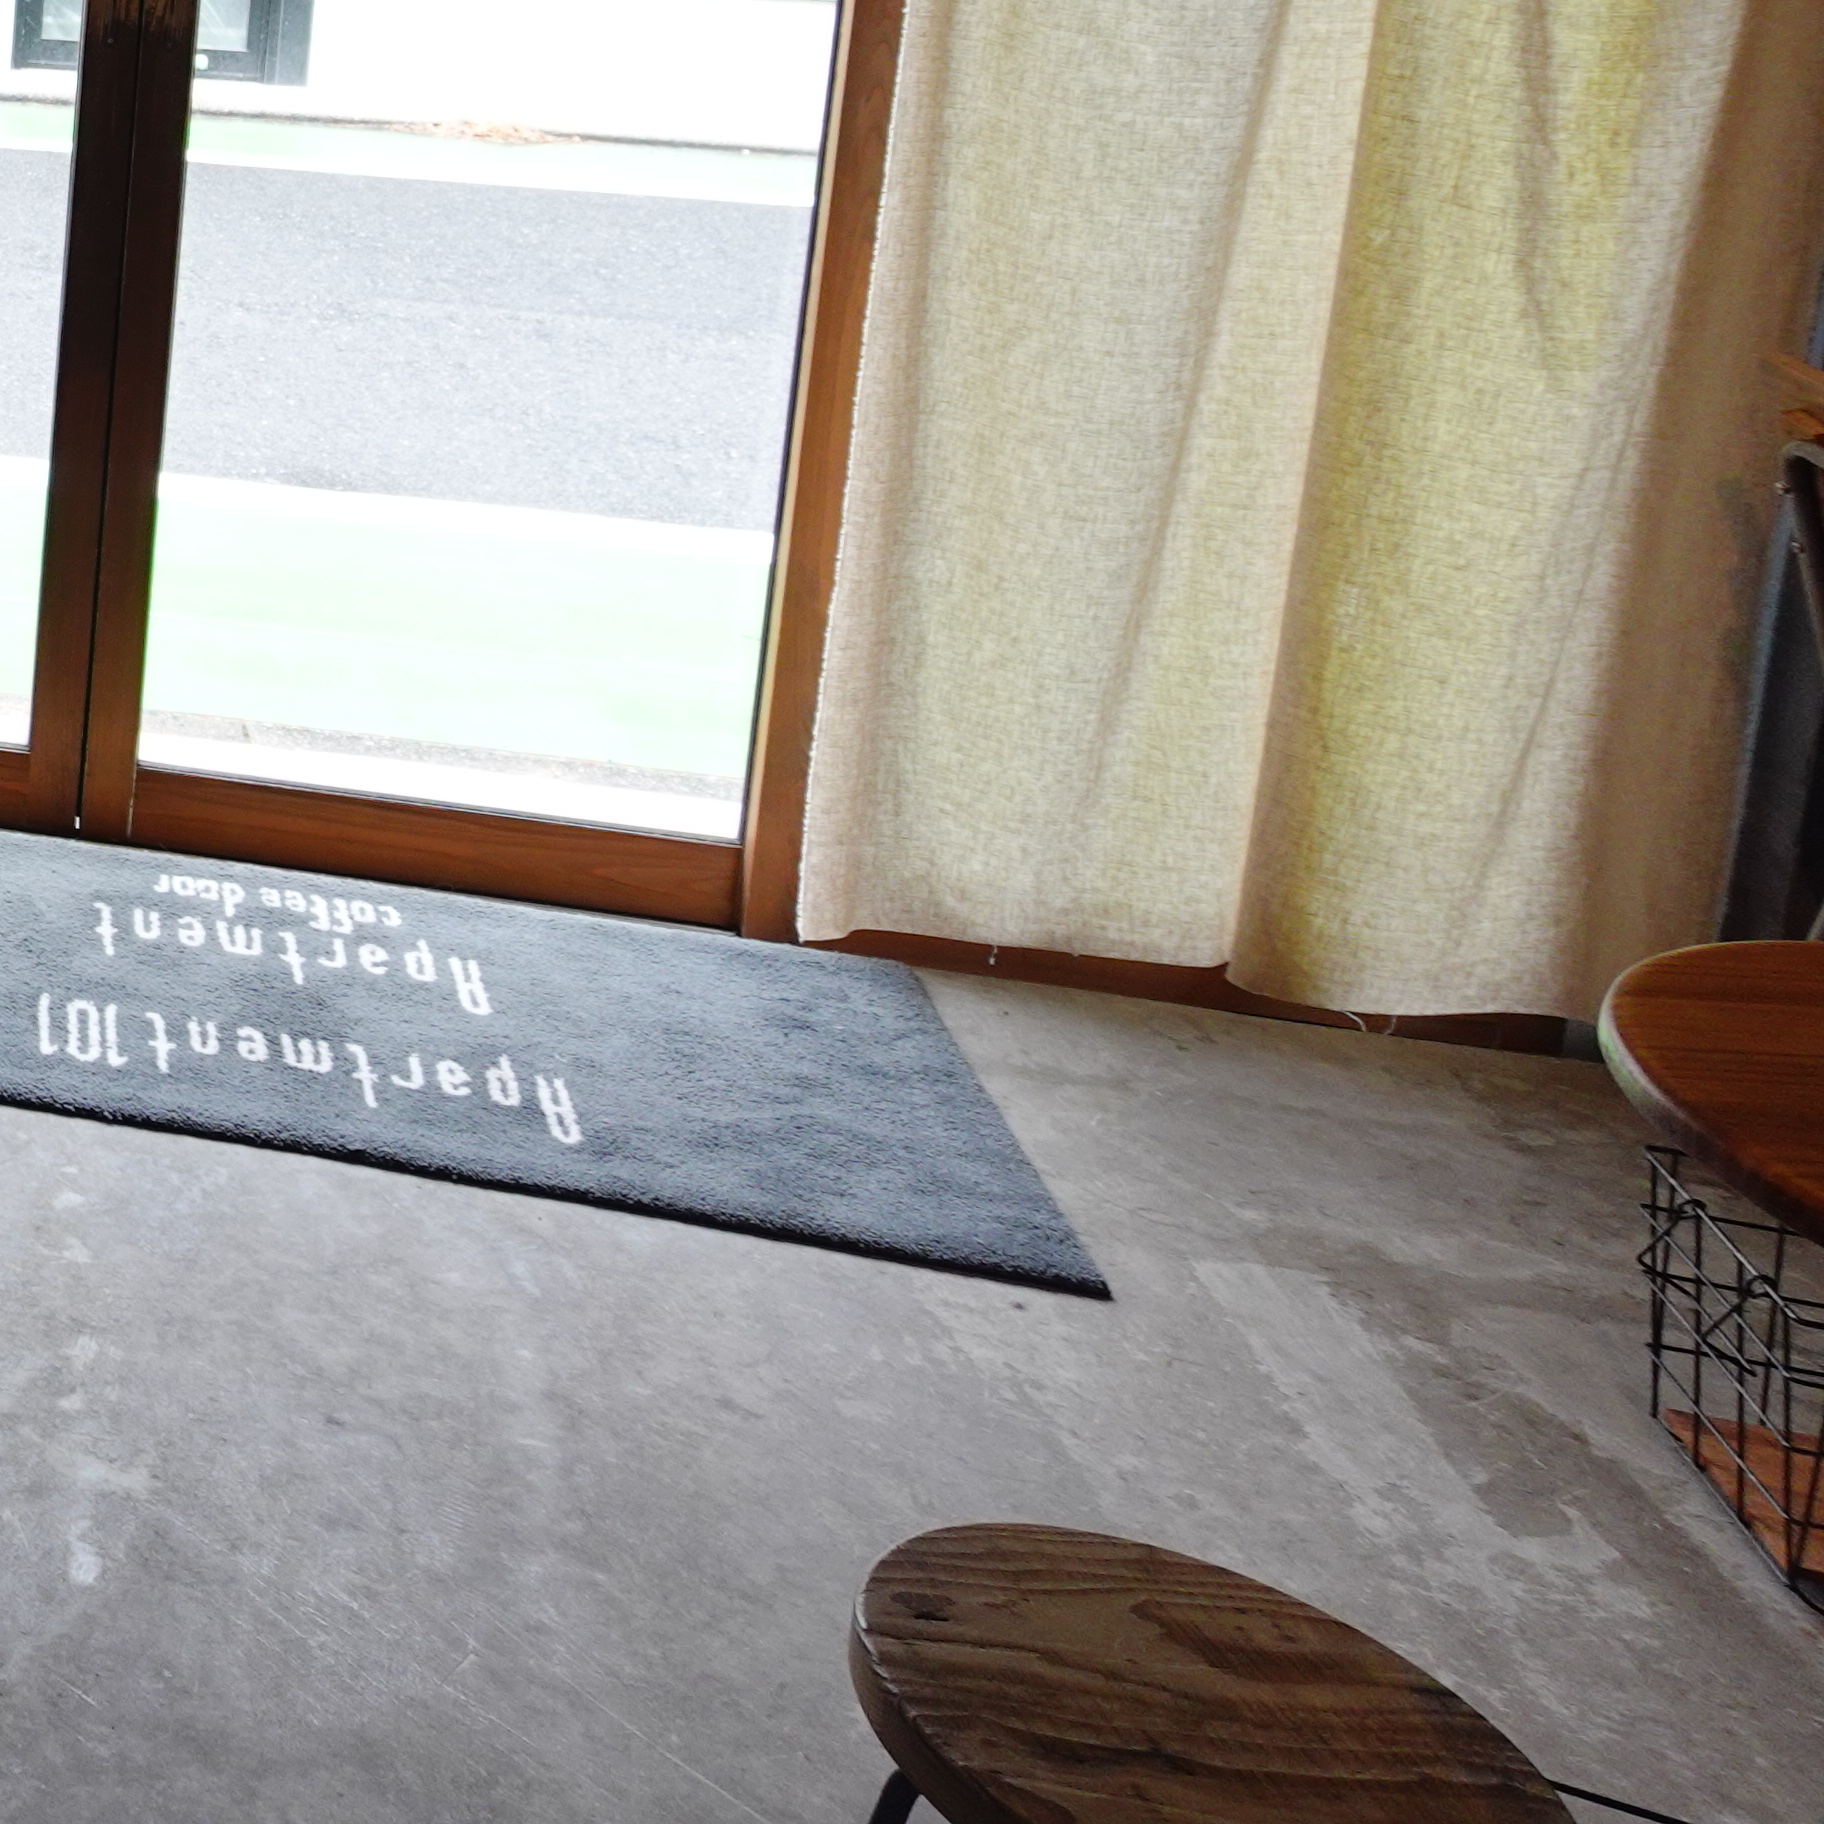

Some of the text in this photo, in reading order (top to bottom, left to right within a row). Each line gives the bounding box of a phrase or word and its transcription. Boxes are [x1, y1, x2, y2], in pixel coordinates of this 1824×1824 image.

[153, 873, 403, 935] coffee door
[93, 902, 493, 1016] Apartment
